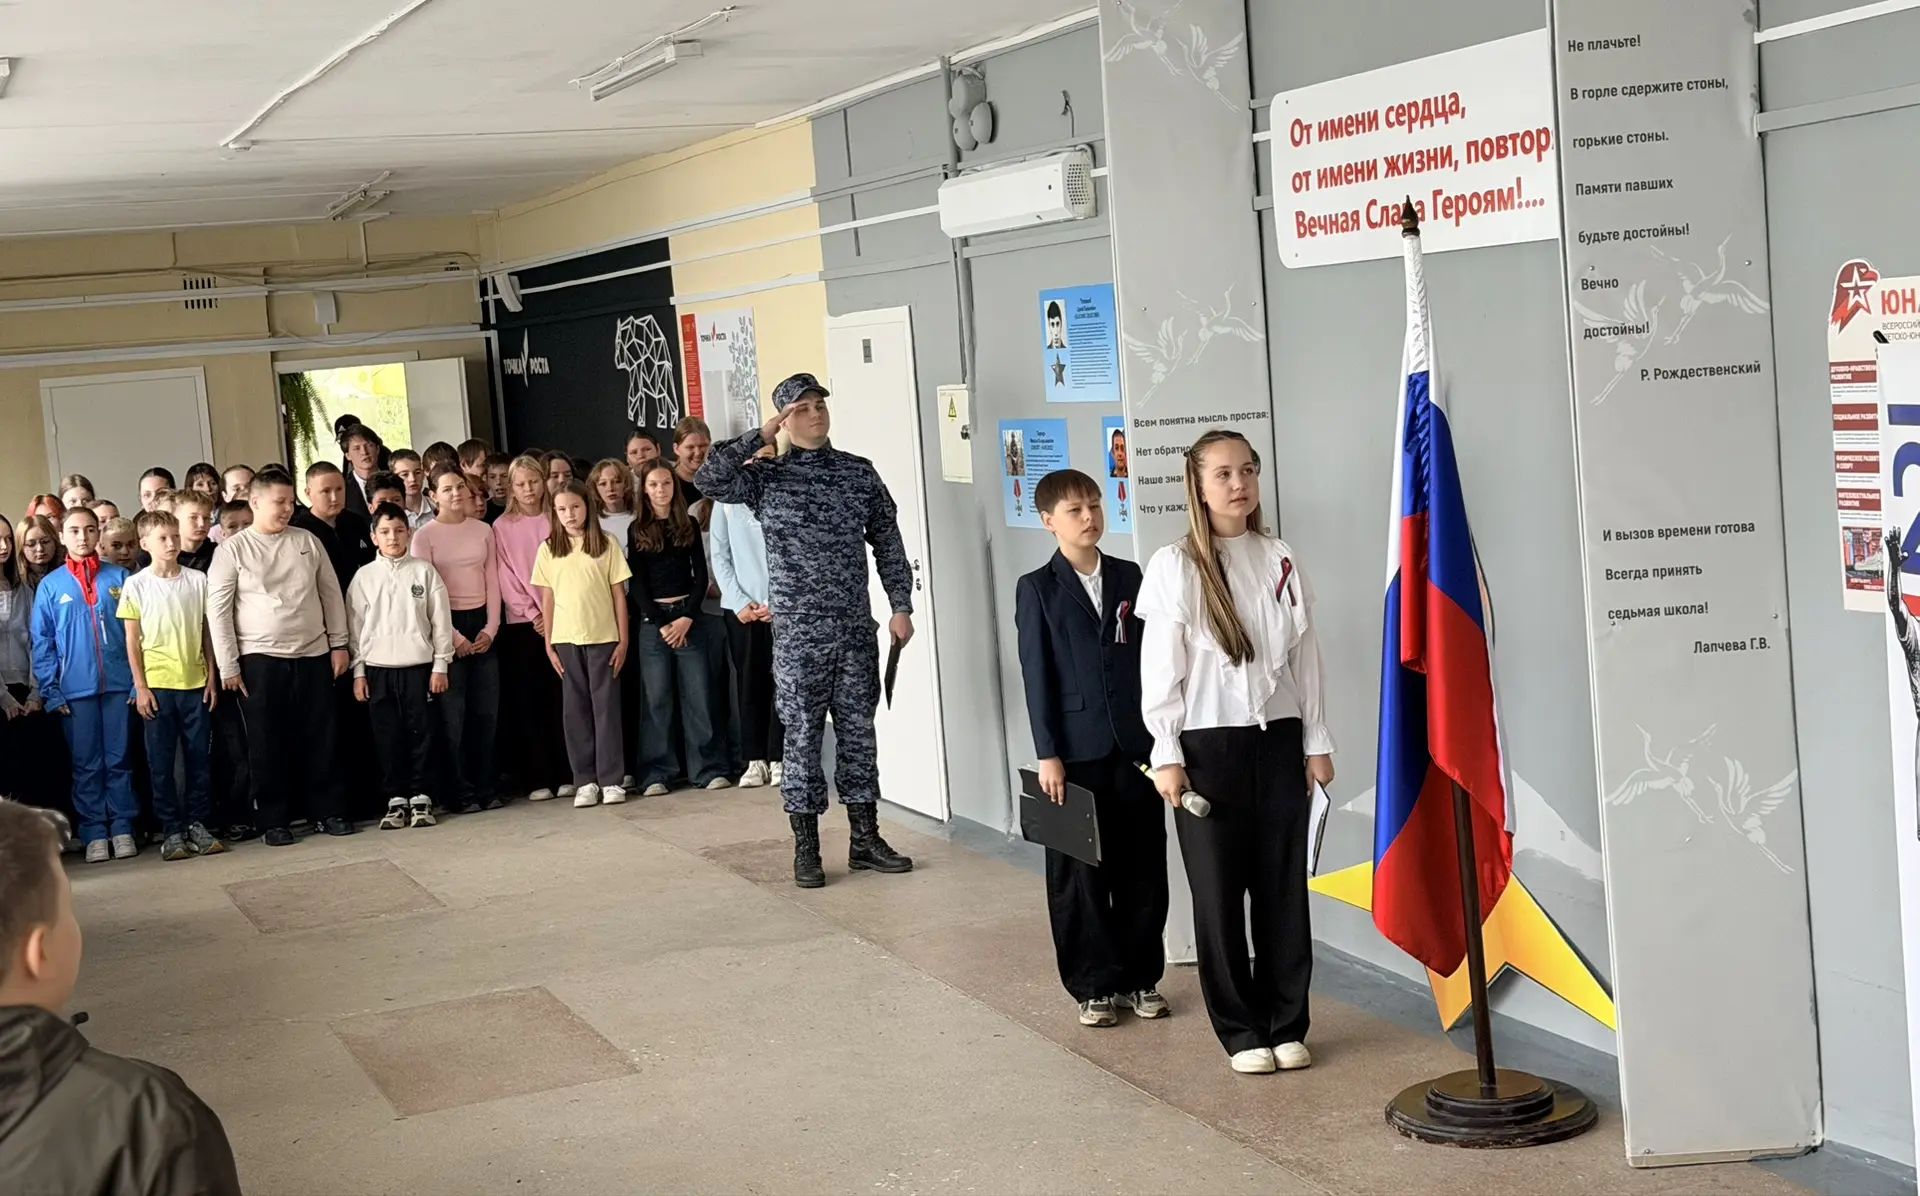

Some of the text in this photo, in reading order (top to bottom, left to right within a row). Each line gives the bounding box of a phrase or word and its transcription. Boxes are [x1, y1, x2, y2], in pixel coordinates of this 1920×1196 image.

[1567, 34, 1641, 52] Не плачьте!
[1570, 77, 1729, 101] В горле сдержите стоны,
[1290, 91, 1466, 148] От имени сердца,
[1572, 131, 1669, 150] горькие стоны.
[1291, 126, 1554, 193] от имени жизни, повтор
[1575, 178, 1674, 196] Памяти павших
[1295, 176, 1545, 239] Вечная Слаа Героям!...
[1578, 222, 1690, 245] будьте достойны!
[1581, 276, 1619, 291] Вечно
[1880, 287, 1920, 316] ЮН
[1583, 321, 1650, 340] достойны!
[529, 356, 550, 375] РОСТА
[1640, 360, 1761, 381] Р. Рождественский
[1133, 411, 1269, 428] Всем понятна мысль простая:
[1135, 447, 1152, 457] Нет
[1138, 476, 1164, 486] Наше
[1139, 504, 1156, 514] Что
[1158, 505, 1165, 515] у
[1602, 522, 1756, 542] И вызов времени готова
[1605, 564, 1703, 581] Всегда принять
[1607, 601, 1709, 621] седьмая школа!
[1693, 637, 1771, 654] Лапчева Г.В.
